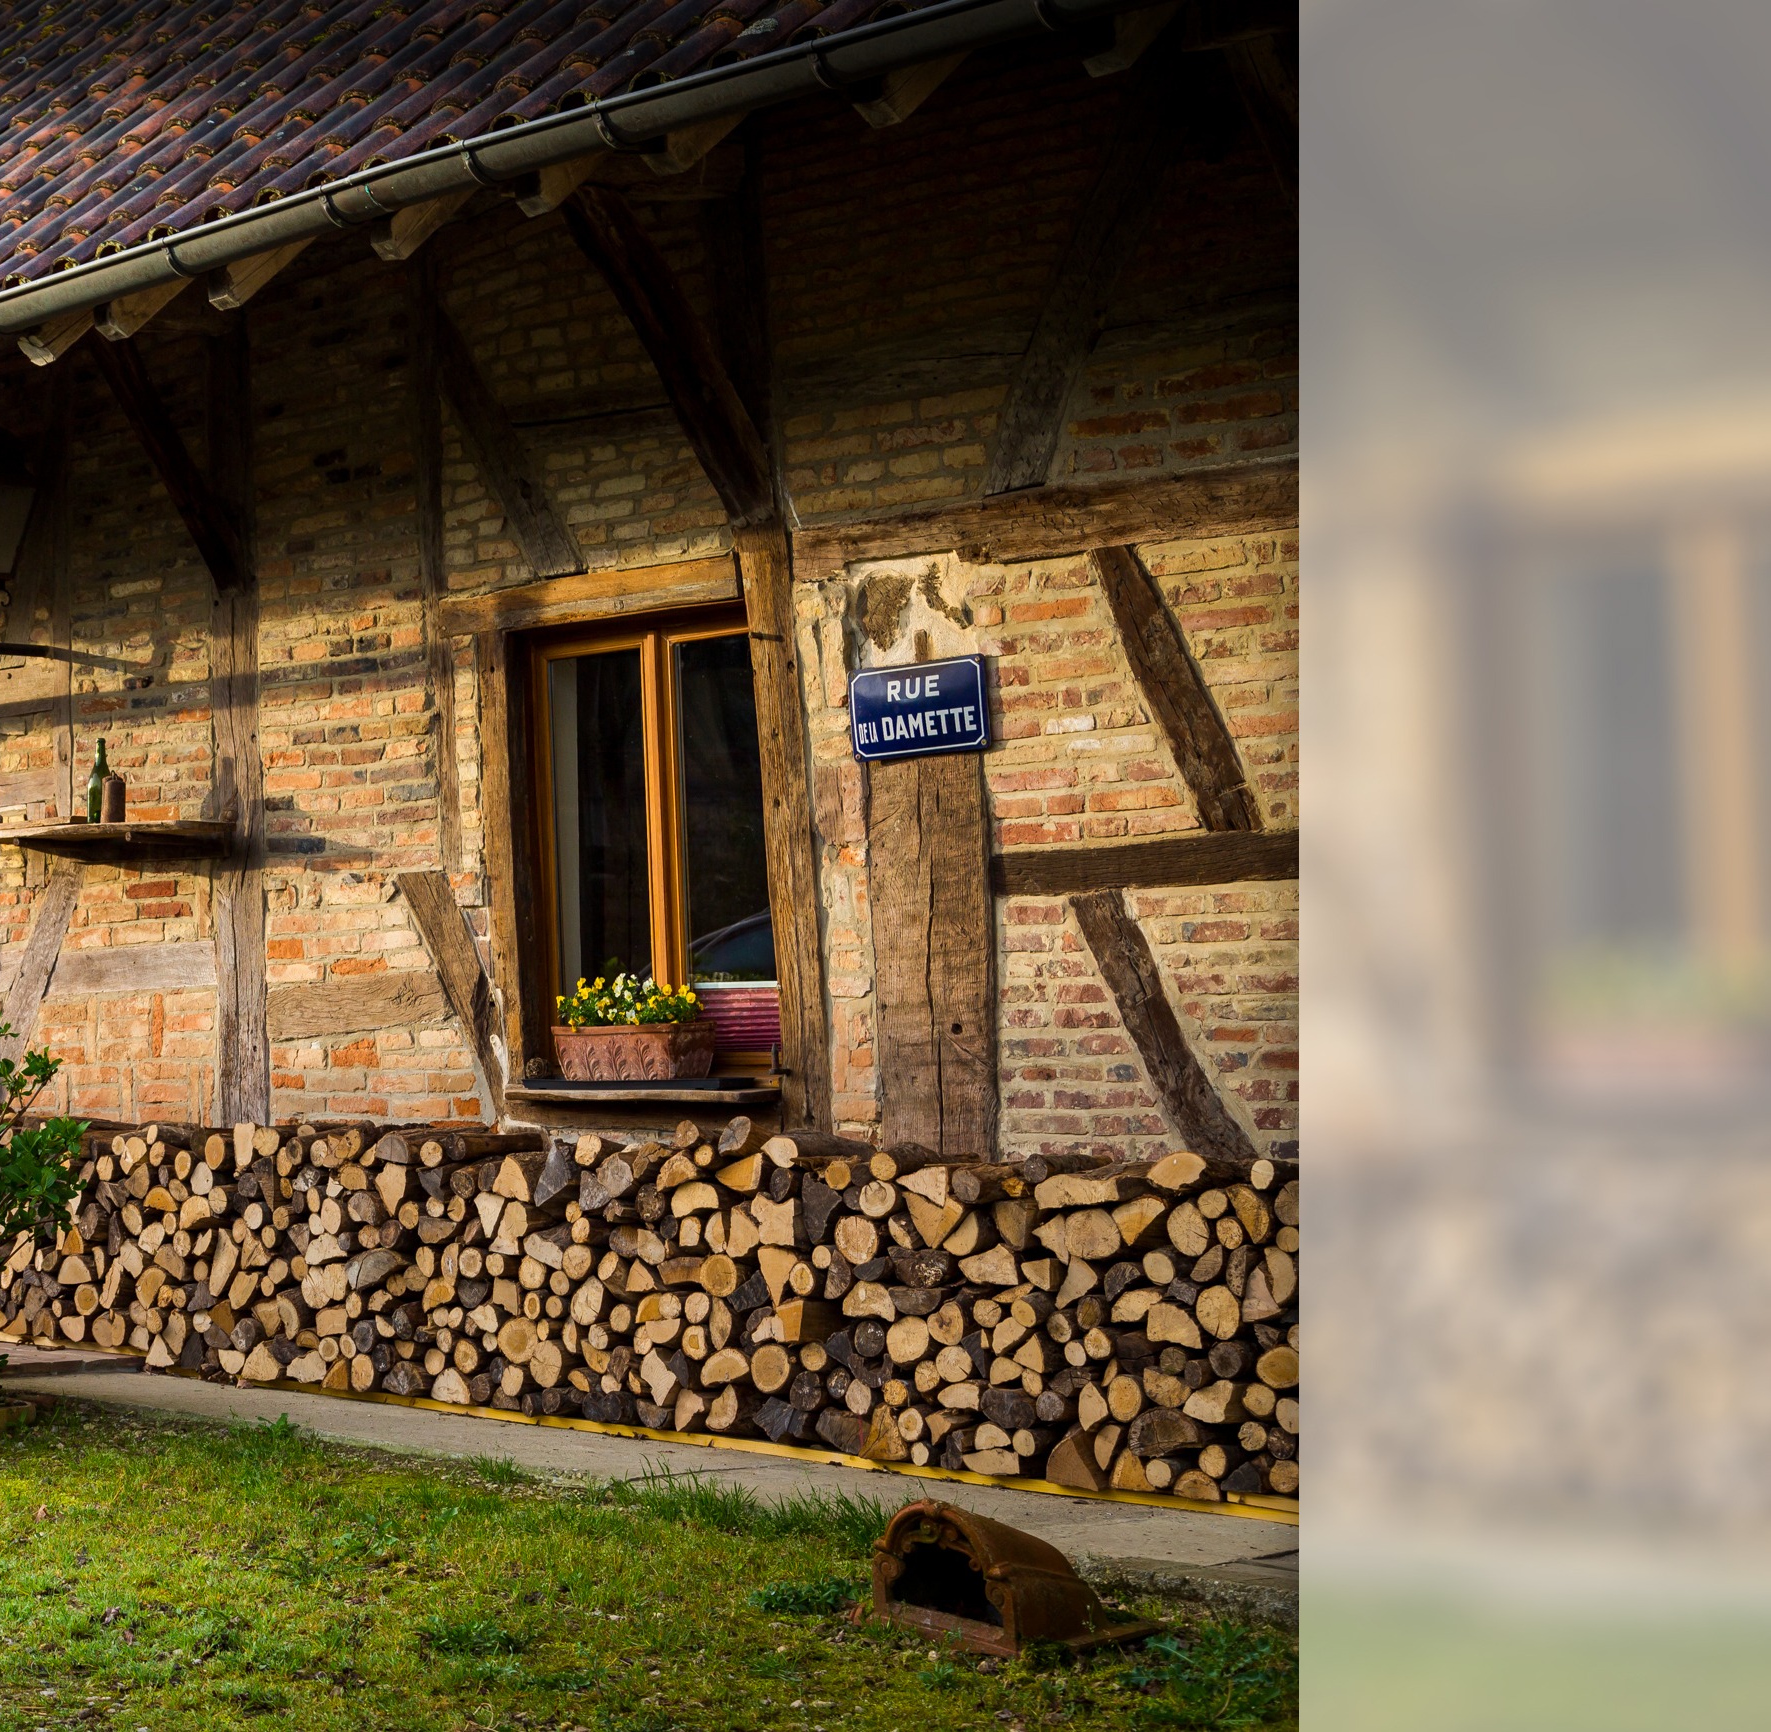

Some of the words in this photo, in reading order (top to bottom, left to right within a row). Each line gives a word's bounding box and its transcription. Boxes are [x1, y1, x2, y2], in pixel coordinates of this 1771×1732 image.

[887, 675, 940, 702] RUE
[858, 723, 868, 745] DE
[868, 722, 879, 743] LA
[881, 705, 978, 741] DAMETTE
